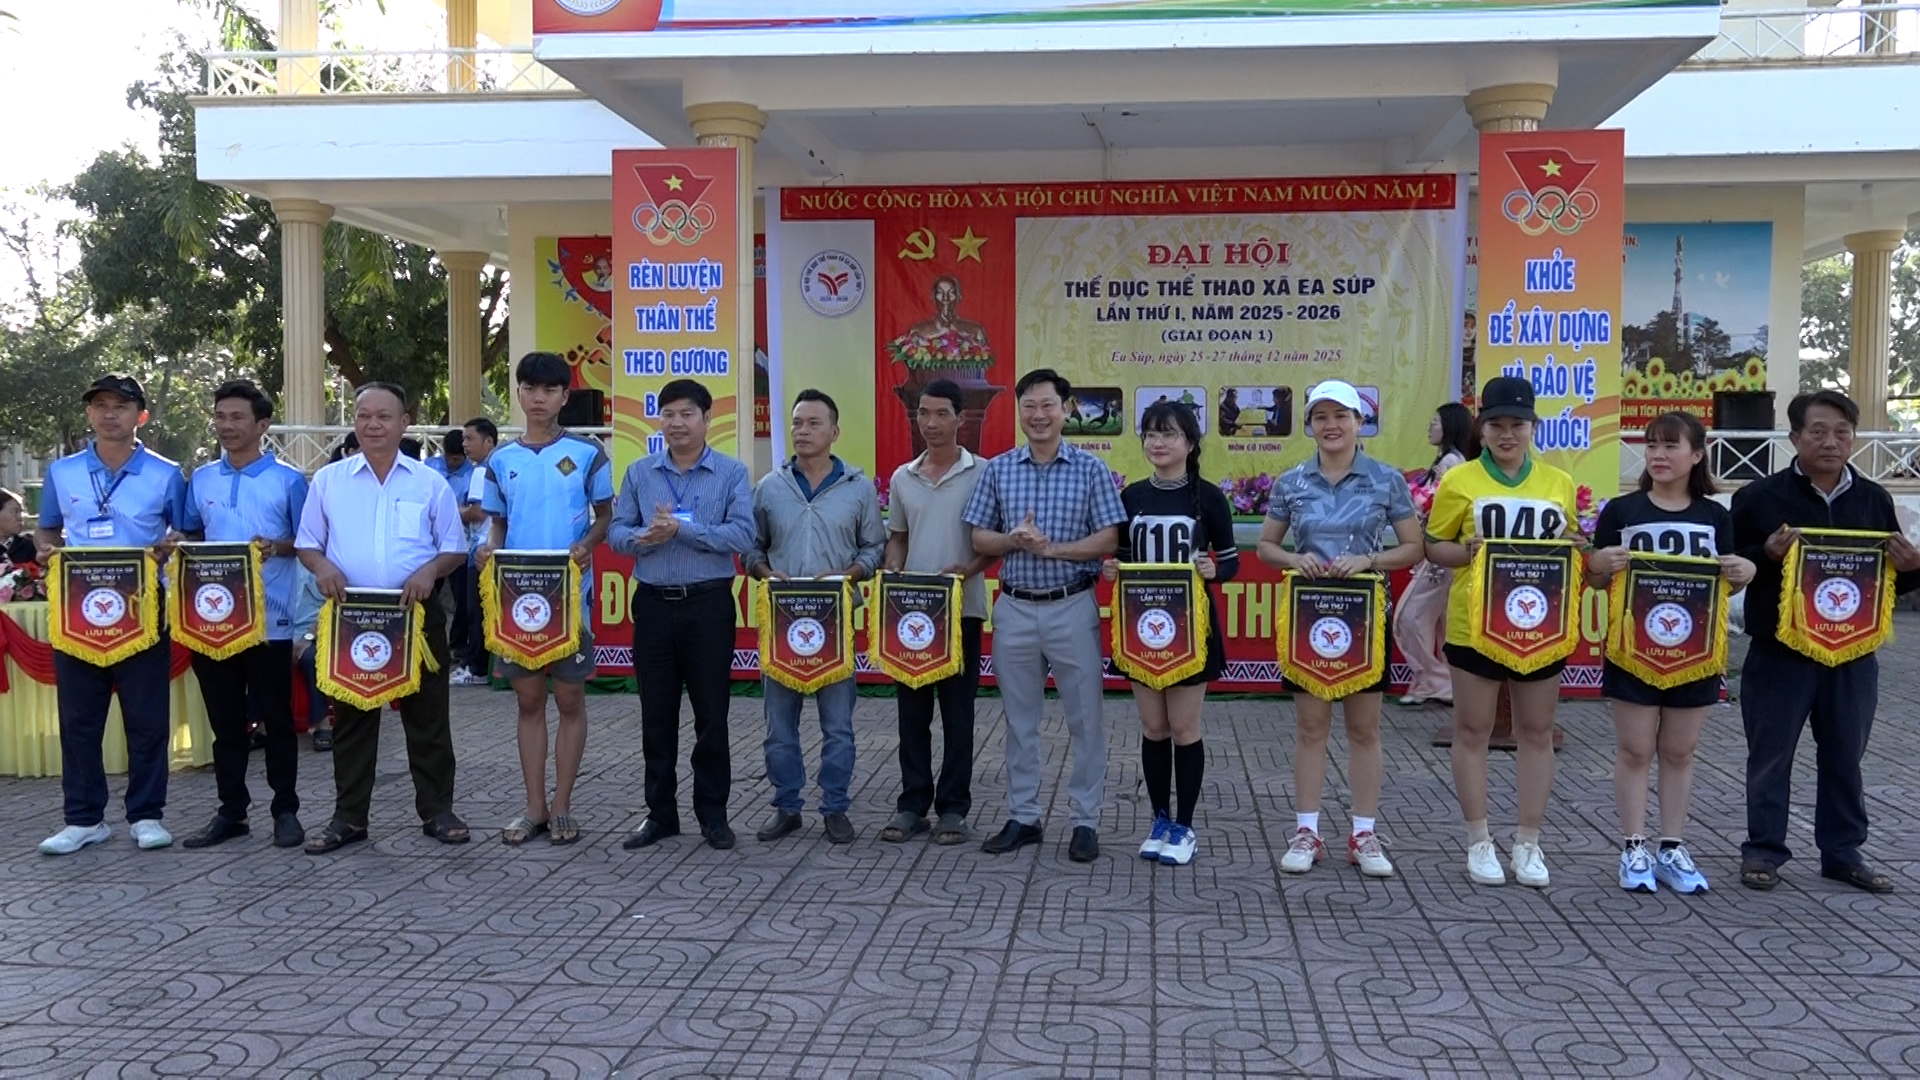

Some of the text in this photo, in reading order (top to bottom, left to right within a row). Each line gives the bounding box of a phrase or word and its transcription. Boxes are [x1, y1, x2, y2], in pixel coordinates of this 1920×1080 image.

[800, 190, 857, 210] NƯỚC
[863, 190, 922, 212] CỘNG
[929, 188, 974, 208] HÒA
[980, 188, 1008, 208] XÃ
[1015, 186, 1053, 210] HỘI
[1059, 185, 1104, 206] CHỦ
[1110, 184, 1180, 204] NGHĨA
[1186, 183, 1238, 207] VIỆT
[1244, 186, 1293, 202] NAM
[1300, 180, 1367, 200] MUÔN
[1374, 179, 1425, 200] NĂM
[1148, 237, 1291, 270] ĐẠI HỘI
[1526, 249, 1575, 290] KHỎE
[630, 258, 721, 293] RÈN LUYỆN
[1064, 273, 1375, 301] THỂ DỤC THỂ THAO XÃ EA SÚP
[636, 298, 717, 330] THÂN THỂ
[1097, 302, 1130, 322] LẦN
[1136, 303, 1171, 320] THỨ
[1192, 303, 1233, 320] NĂM
[1240, 305, 1283, 320] 2025
[1296, 305, 1341, 320] 2026
[1490, 301, 1610, 350] ĐỂ XÂY DỰNG
[1162, 329, 1273, 344] (GIAI ĐOẠN 1)
[624, 350, 728, 374] THEO GƯƠNG
[1111, 351, 1126, 362] Ea
[1159, 351, 1187, 365] ngày
[1229, 350, 1262, 363] tháng
[1267, 350, 1280, 362] 12
[1284, 350, 1308, 362] năm
[1313, 350, 1341, 362] 2025
[1532, 355, 1567, 396] BẢO
[1573, 359, 1595, 402] VỆ
[1535, 407, 1591, 452] QUỐC!
[1481, 503, 1562, 540] 048
[1132, 523, 1190, 563] 016
